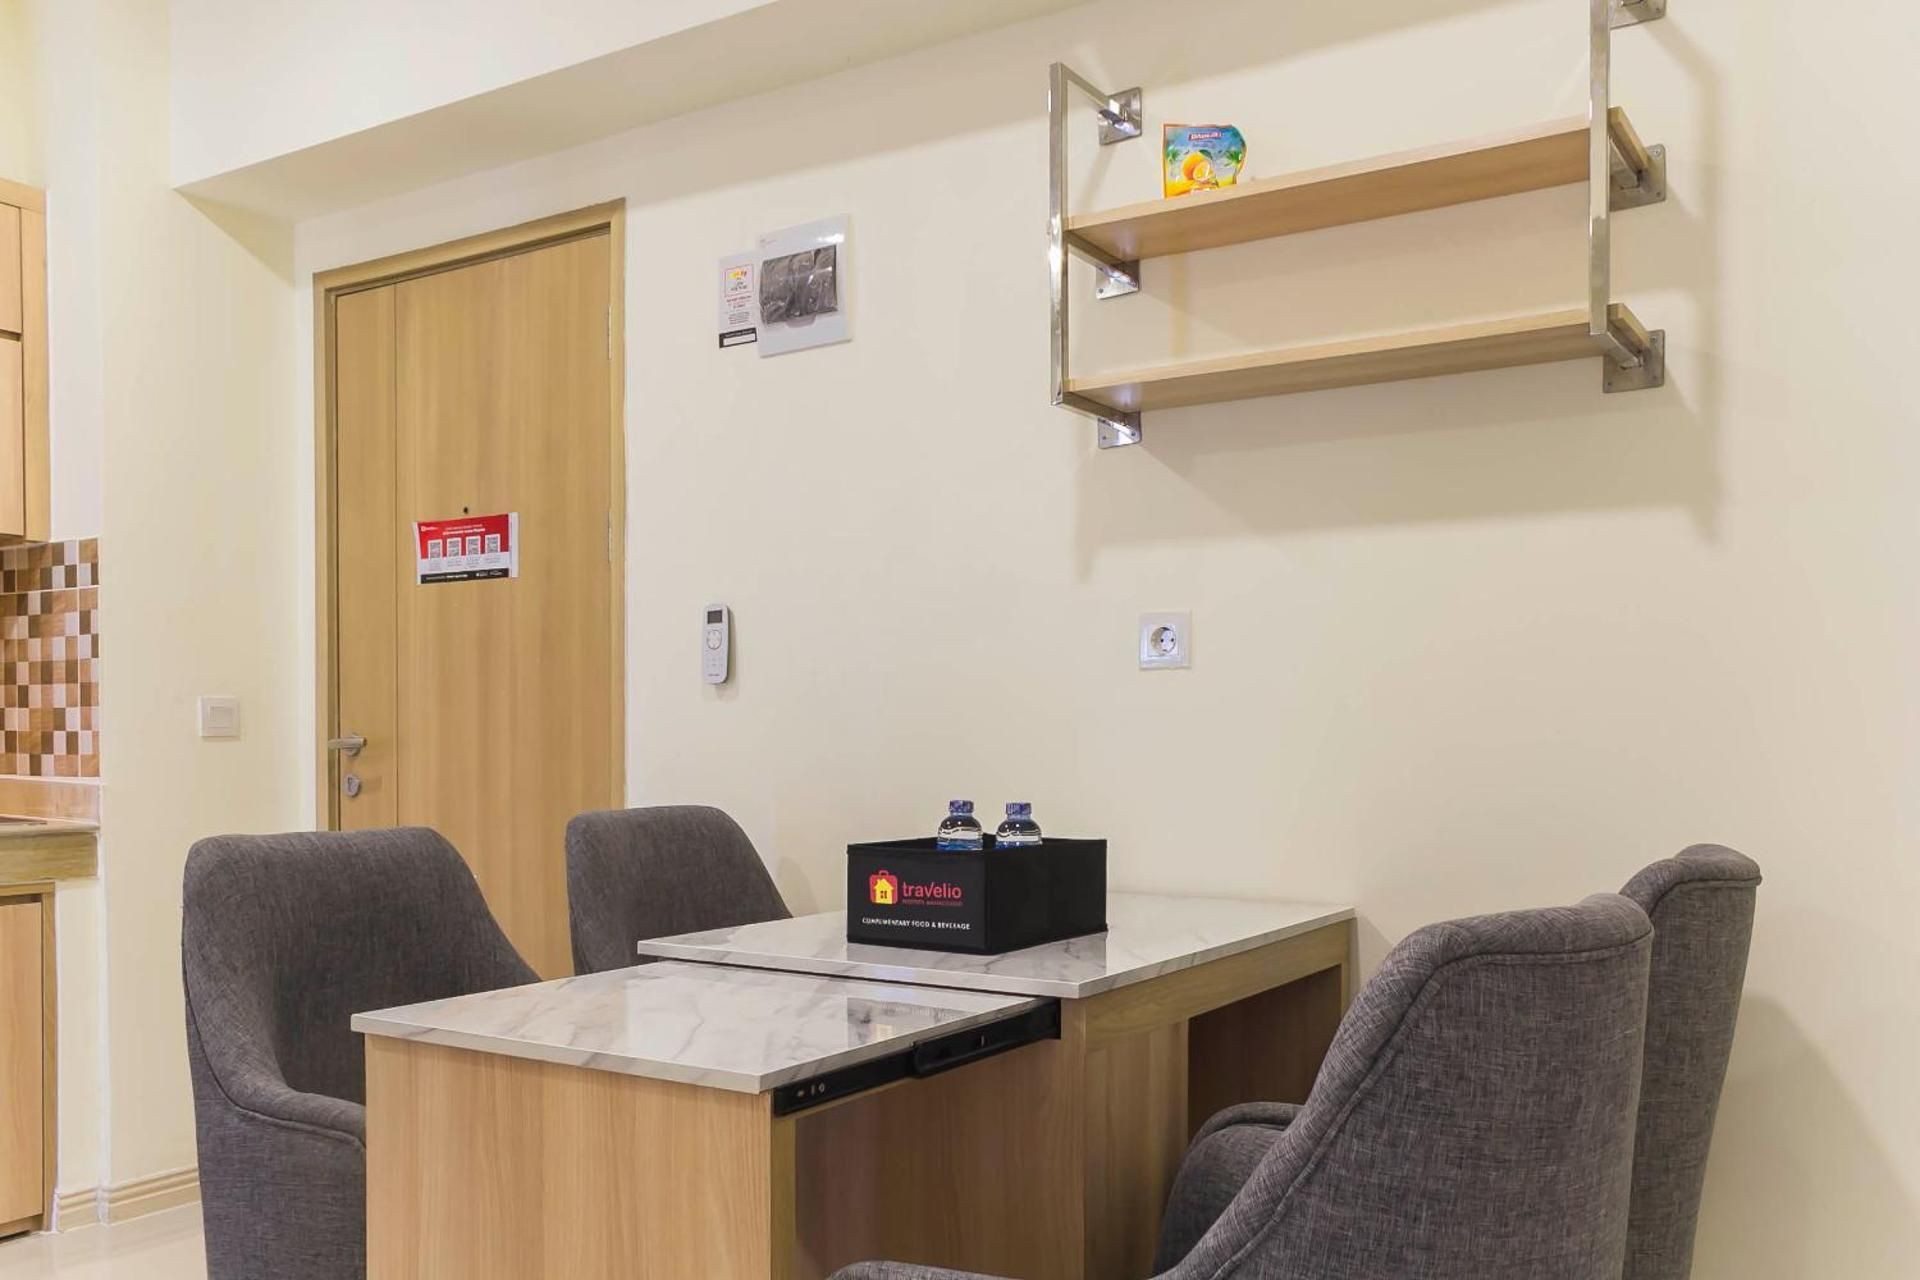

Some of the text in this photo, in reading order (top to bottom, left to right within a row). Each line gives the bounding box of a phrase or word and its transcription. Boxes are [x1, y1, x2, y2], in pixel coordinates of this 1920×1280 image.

[902, 881, 962, 899] travelio
[912, 919, 930, 928] FOOD
[937, 921, 971, 930] BEVERAGE
